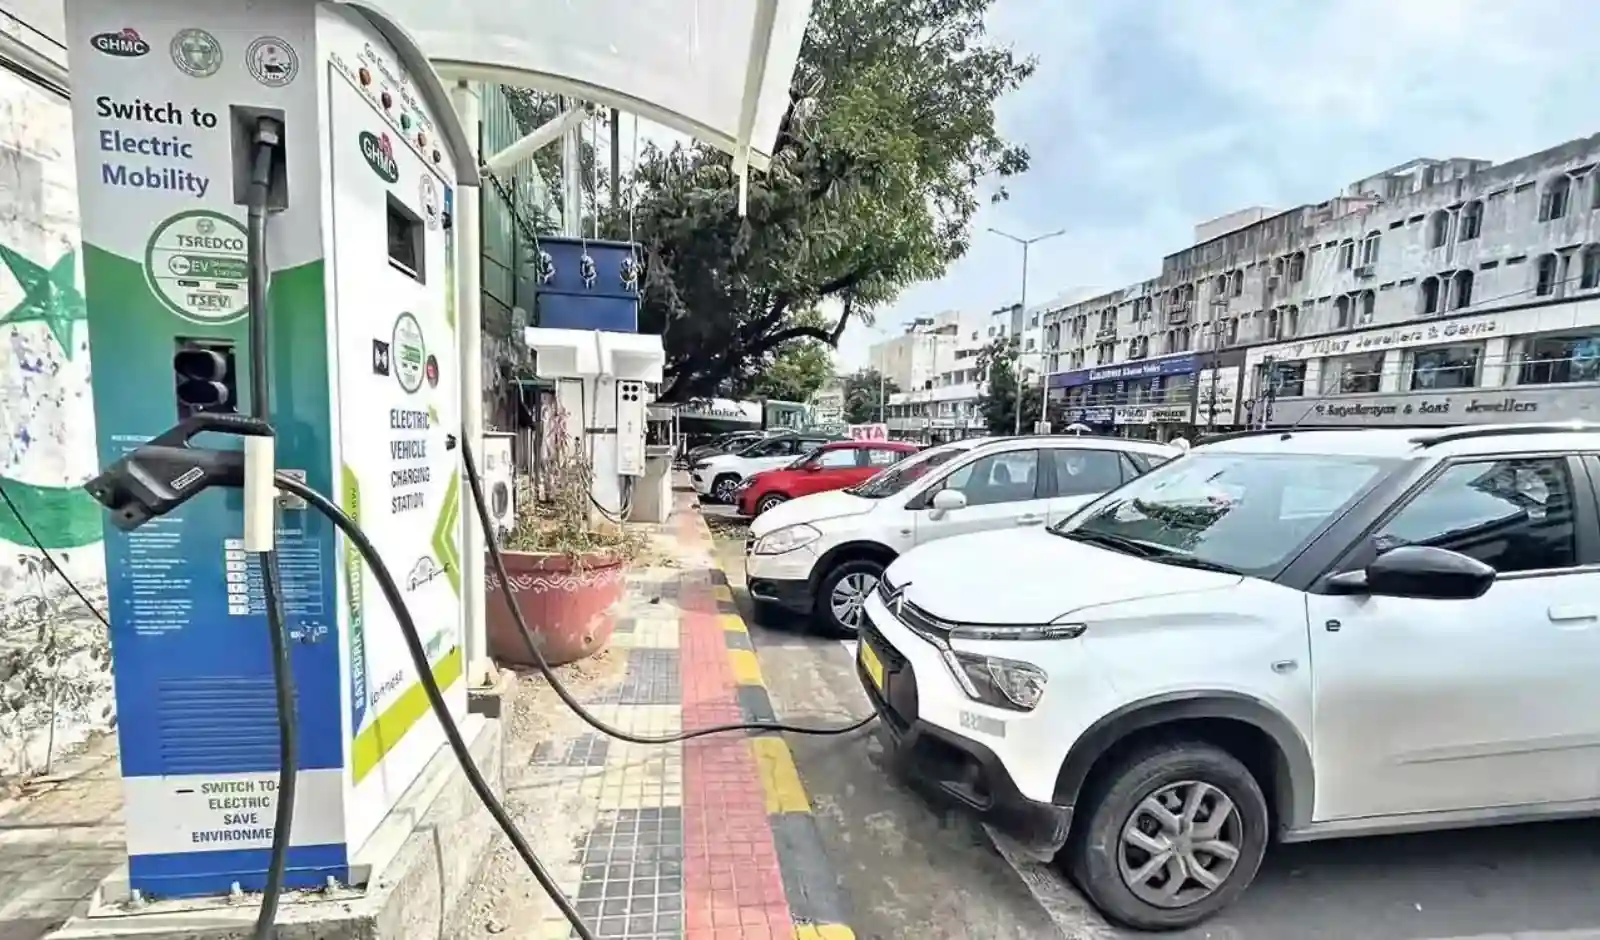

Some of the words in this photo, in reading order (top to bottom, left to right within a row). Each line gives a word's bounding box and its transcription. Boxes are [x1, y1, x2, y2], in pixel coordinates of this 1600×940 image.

[97, 37, 145, 54] GHMC
[96, 96, 182, 125] Switch
[191, 106, 217, 128] to
[99, 130, 193, 158] Electric
[363, 138, 398, 180] GHMC
[101, 163, 210, 198] Mobility
[176, 234, 244, 251] TSREDCO
[192, 260, 208, 272] EV
[1465, 398, 1538, 412] Jewellers
[390, 408, 430, 430] ELECTRIC
[852, 426, 885, 440] RTA
[390, 440, 426, 460] VEHICLE
[391, 466, 430, 488] CHARGING
[392, 492, 424, 514] STATION
[201, 781, 255, 794] SWITCH
[258, 780, 275, 792] TO
[208, 796, 270, 810] ELECTRIC
[223, 812, 258, 825] SAVE
[192, 828, 277, 842] ENVIRONME
